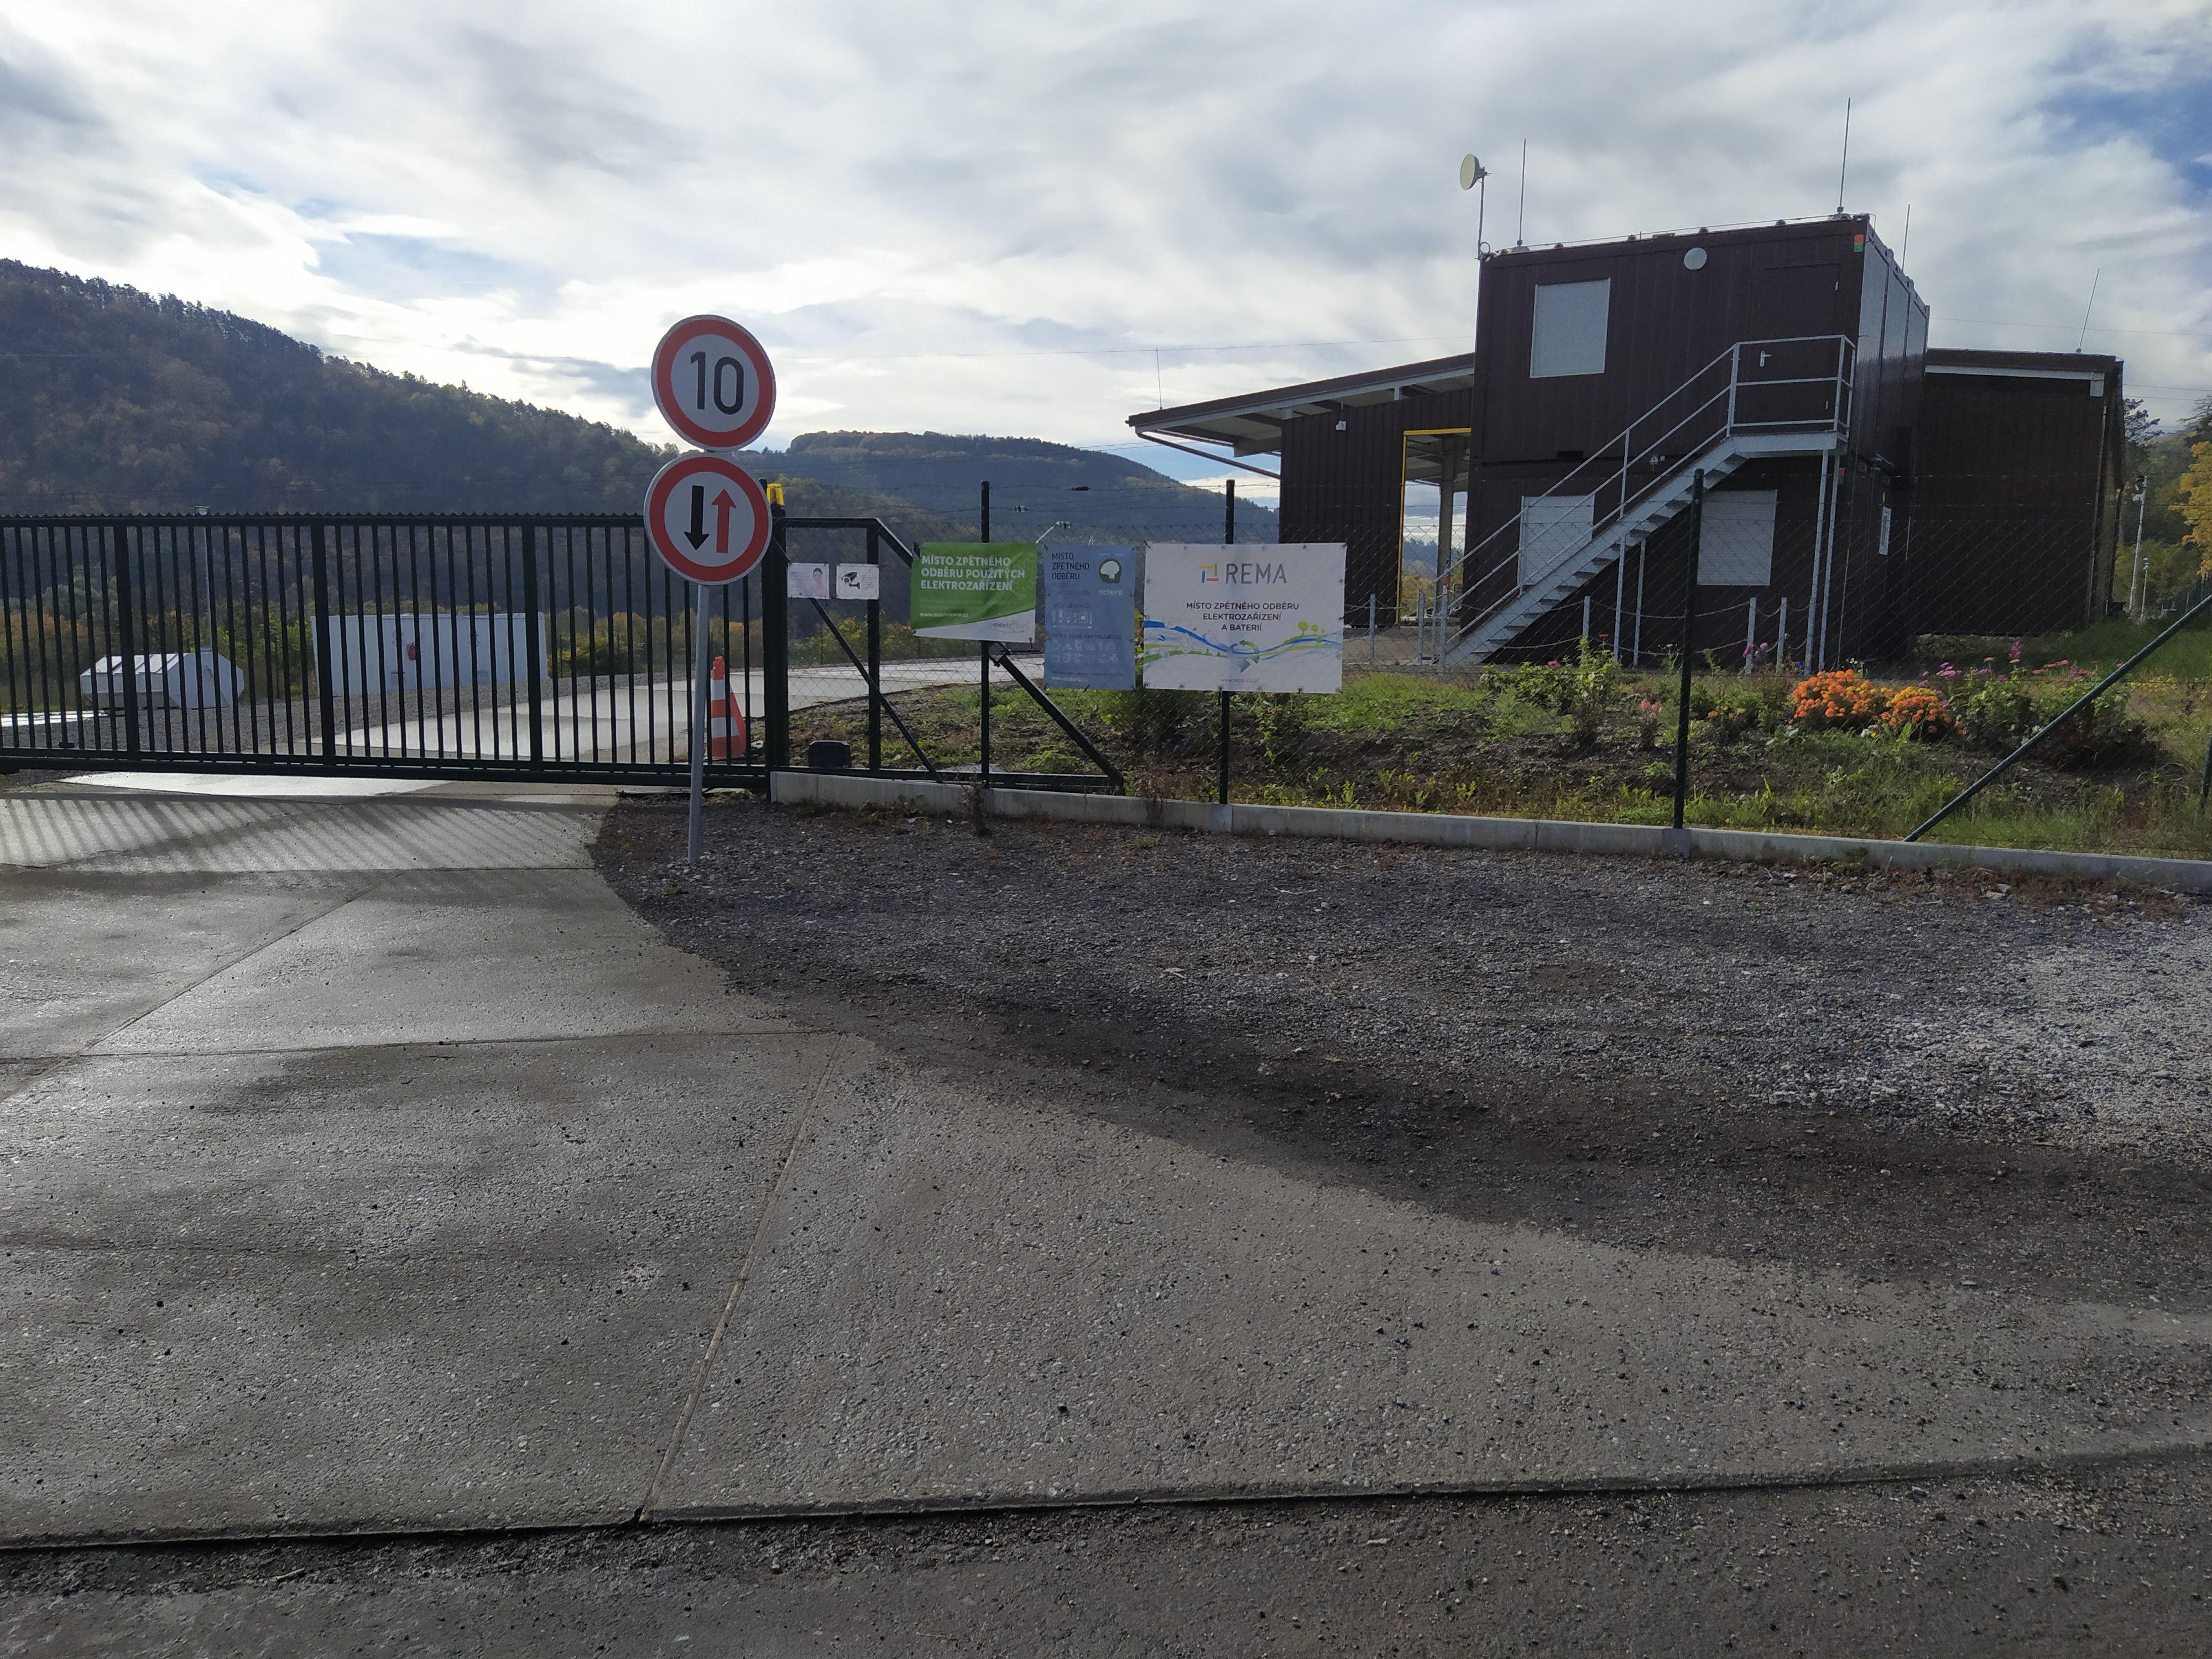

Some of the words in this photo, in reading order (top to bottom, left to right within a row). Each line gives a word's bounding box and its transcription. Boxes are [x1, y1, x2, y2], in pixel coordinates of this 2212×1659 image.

[690, 351, 744, 415] 10
[922, 554, 954, 565] MÍSTO
[956, 555, 1011, 566] ZPĚTNÉHO
[1051, 551, 1074, 560] MÍSTO
[1052, 561, 1090, 570] ZPĚTNÉHO
[921, 566, 963, 577] ODBĚRU
[966, 567, 1025, 578] POUŽITÝCH
[1051, 571, 1080, 580] ODBĚRU
[1225, 563, 1287, 584] REMA
[921, 579, 1013, 591] ELEKTROZAŘÍZENÍ
[1186, 601, 1212, 610] MÍSTO
[1214, 601, 1260, 611] ZPĚTNÉHO
[1262, 601, 1300, 611] ODBĚRU
[1203, 611, 1282, 621] ELEKTROZAŘÍZENÍ
[1230, 622, 1262, 632] BATERIÍ
